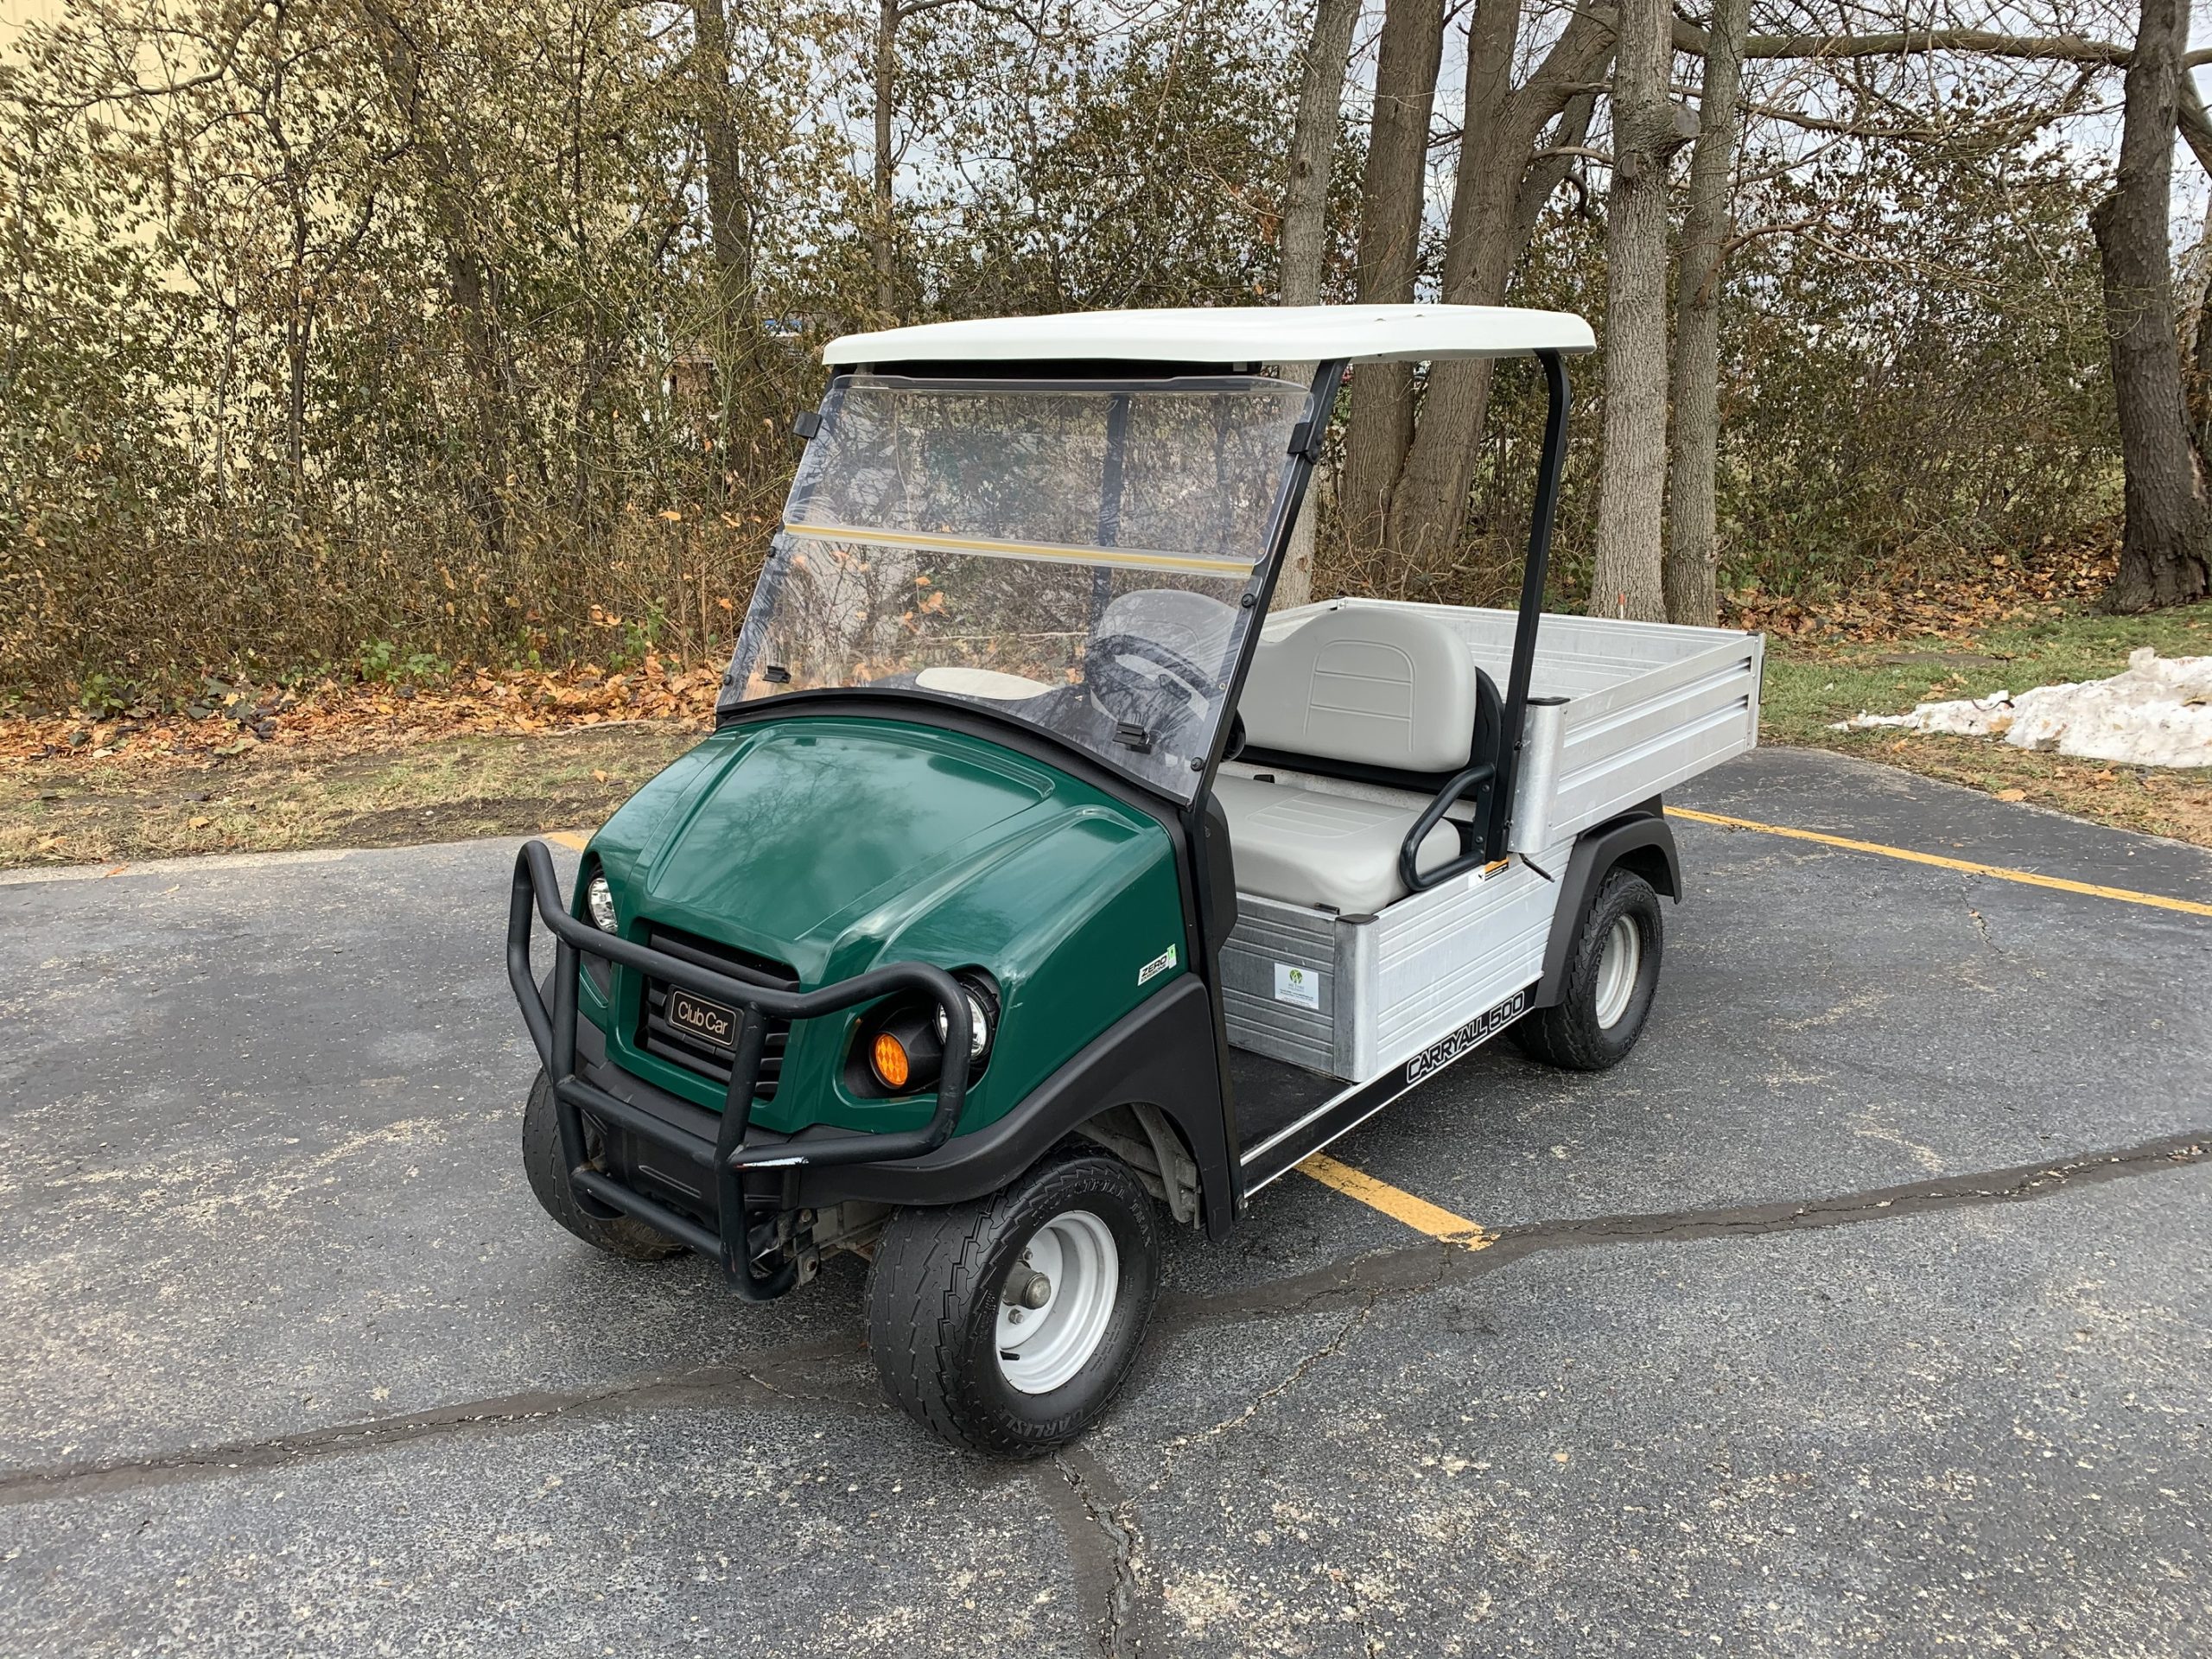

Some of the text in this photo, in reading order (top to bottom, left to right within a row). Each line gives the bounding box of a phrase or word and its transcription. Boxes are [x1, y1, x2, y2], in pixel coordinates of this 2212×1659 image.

[1141, 955, 1167, 977] ZERO
[677, 1001, 728, 1035] Club Car
[1407, 990, 1525, 1084] CARRYALL 500
